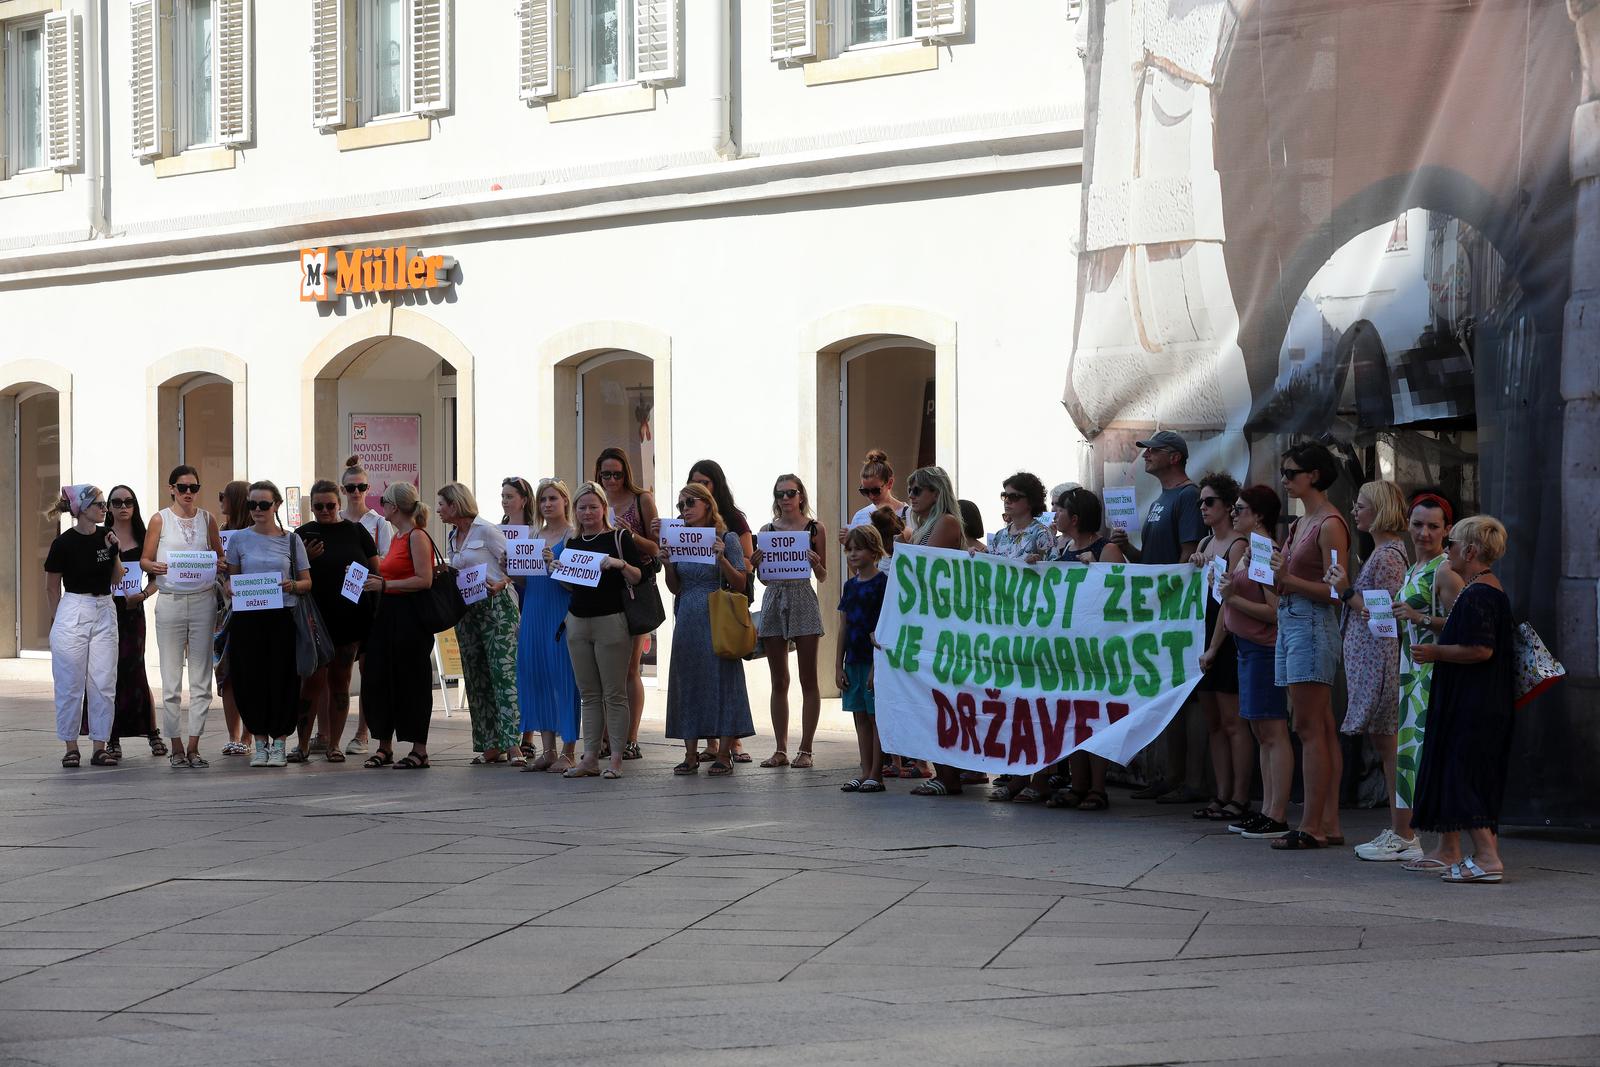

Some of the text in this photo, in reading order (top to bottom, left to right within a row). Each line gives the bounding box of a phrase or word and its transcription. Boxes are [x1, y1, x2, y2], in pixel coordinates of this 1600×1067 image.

[306, 245, 444, 294] M Müller
[354, 443, 390, 452] NOVOSTI
[364, 463, 417, 473] PARFUMERIJE
[502, 530, 519, 540] TOP
[679, 532, 703, 544] STOP
[771, 537, 796, 548] STOP
[515, 544, 535, 555] STOP
[570, 553, 594, 565] STOP
[761, 551, 807, 562] FEMICIDU!
[169, 561, 215, 569] JE ODGOVORNOST
[508, 559, 544, 570] FEMICIDU!
[179, 571, 202, 579] DRŽAVE!
[352, 568, 364, 581] STOP
[466, 571, 479, 583] STOP
[556, 566, 600, 580] FEMICIDU!
[233, 578, 278, 587] SIGURNOST ŽENA
[241, 588, 280, 597] ODGOVORNOST
[895, 555, 1205, 629] SIGURNOST ŽENA
[245, 599, 269, 607] DRŽAVE!
[885, 625, 1193, 698] JE ODGOVORNOST
